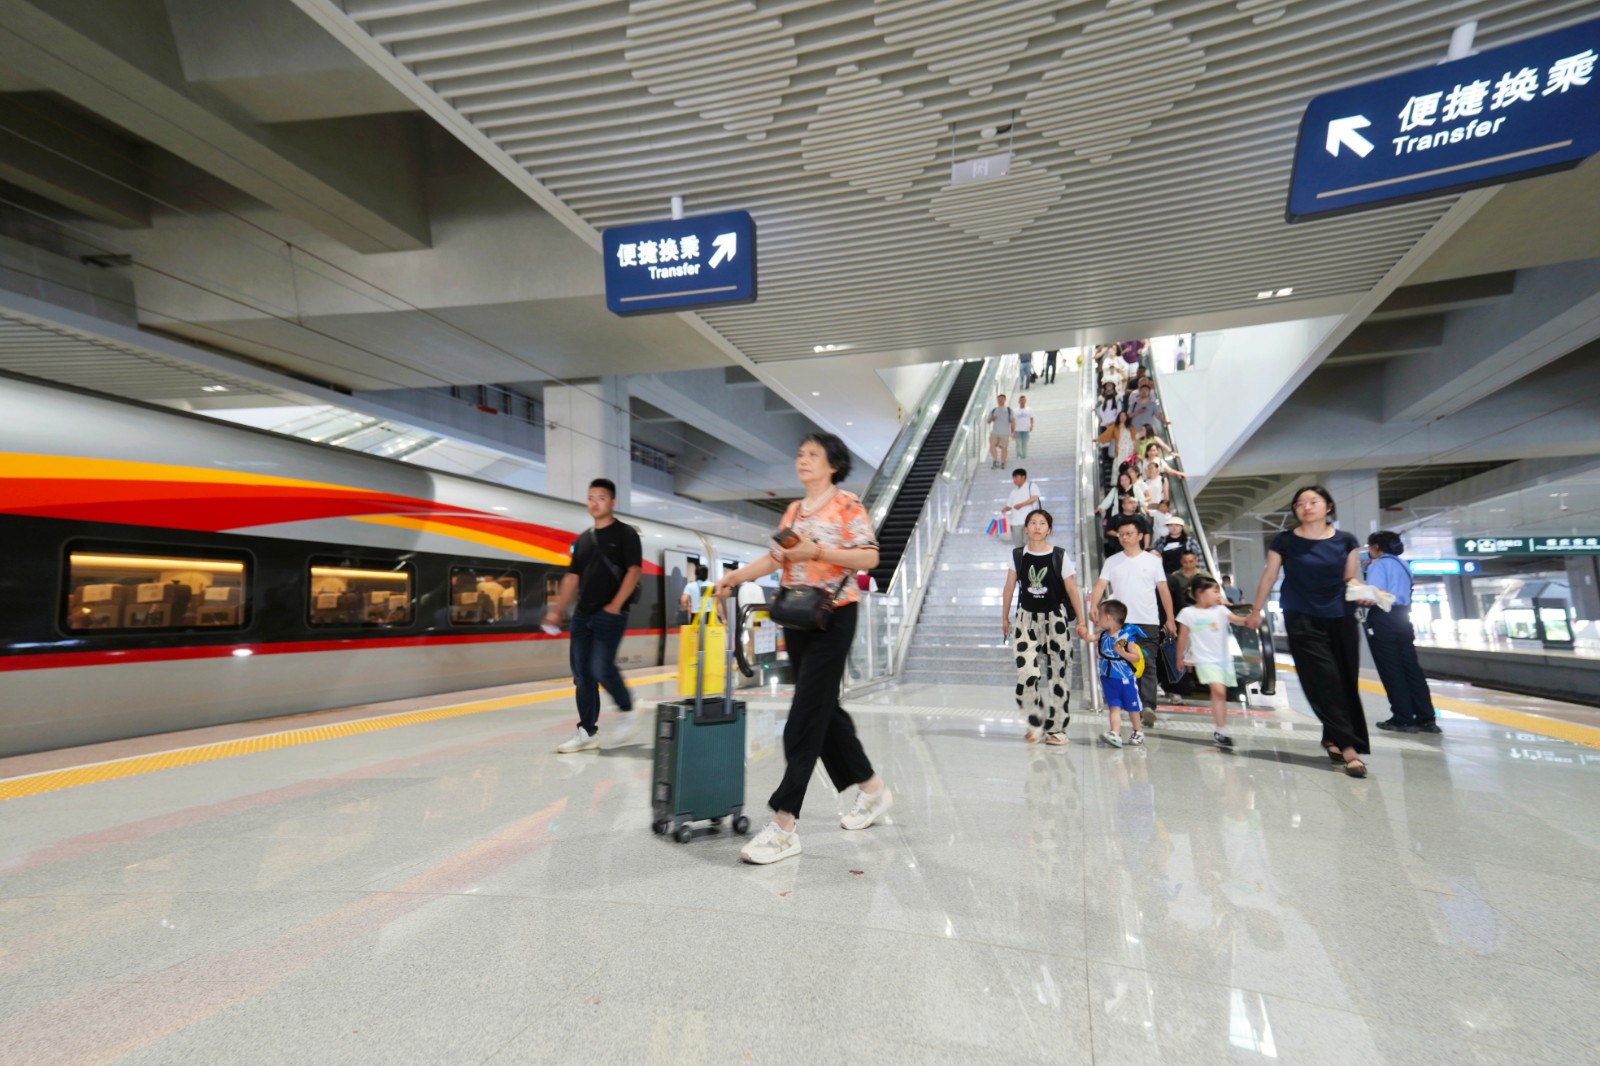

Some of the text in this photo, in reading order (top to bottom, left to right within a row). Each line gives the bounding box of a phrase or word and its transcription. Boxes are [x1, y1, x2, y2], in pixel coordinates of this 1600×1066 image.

[1397, 49, 1599, 133] 便捷换乘
[1392, 116, 1505, 156] Transfer
[616, 234, 700, 268] 便捷换乘
[648, 262, 701, 280] Transfer
[1464, 561, 1475, 572] 6
